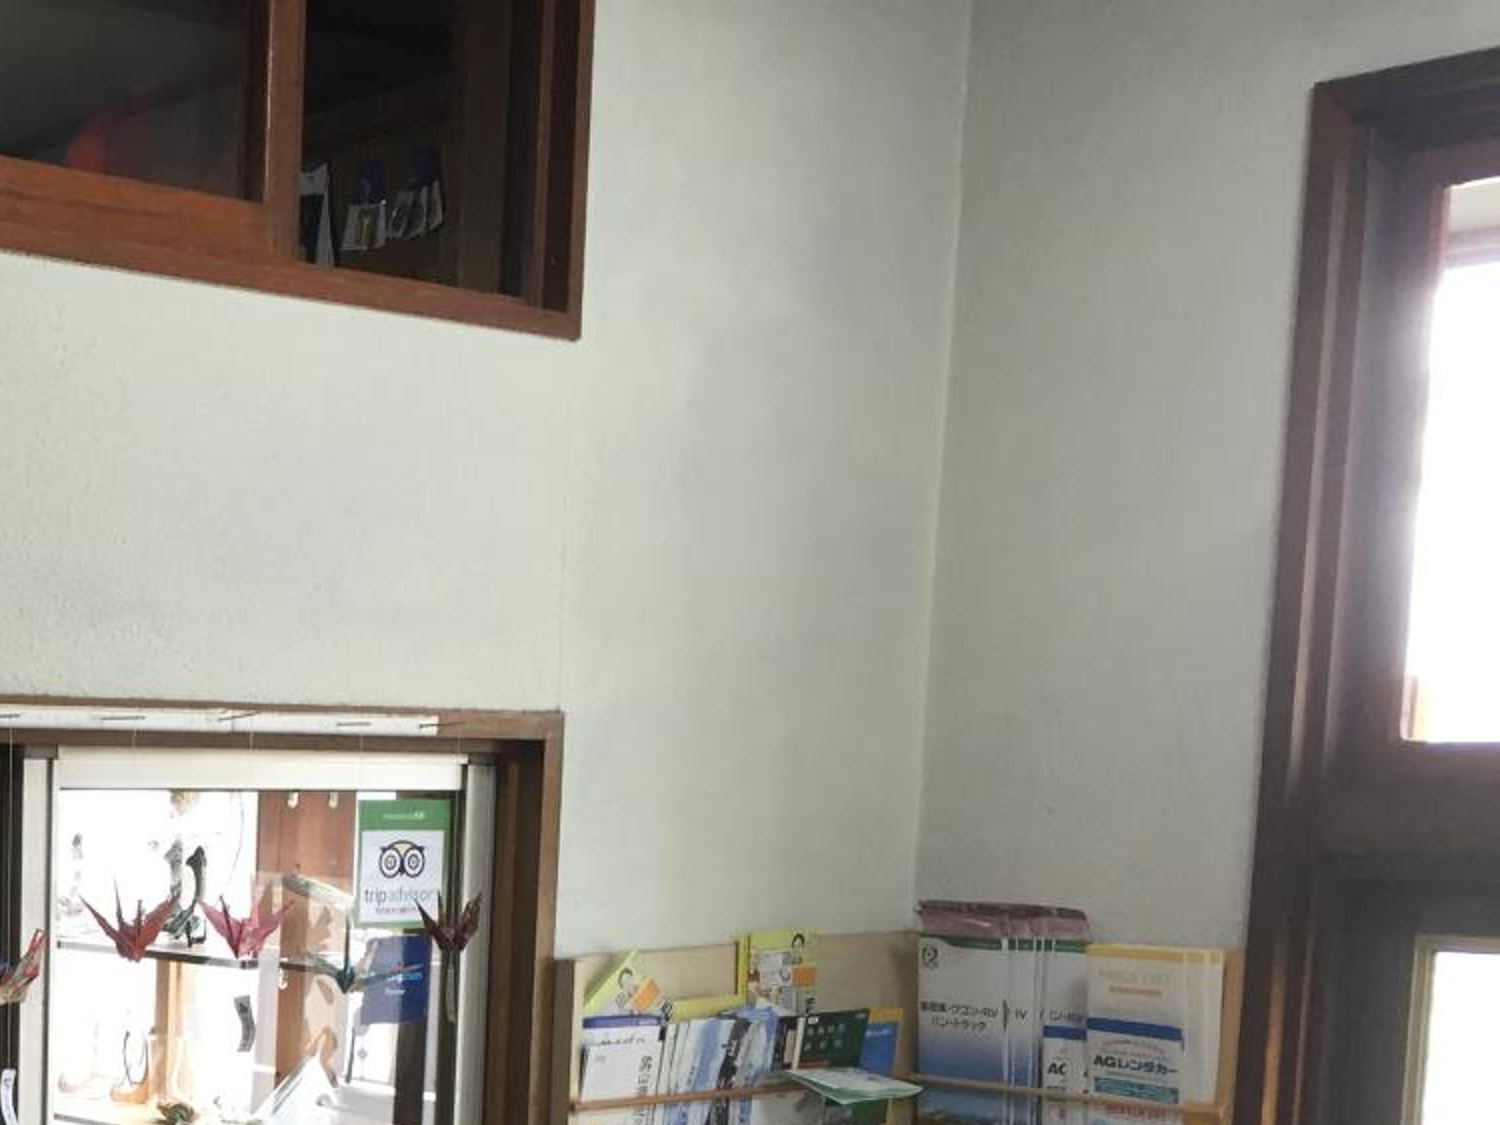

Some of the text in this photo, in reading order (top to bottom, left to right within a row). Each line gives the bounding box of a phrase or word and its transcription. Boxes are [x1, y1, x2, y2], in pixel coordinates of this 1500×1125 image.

[1093, 1054, 1179, 1076] AGレンタカー
